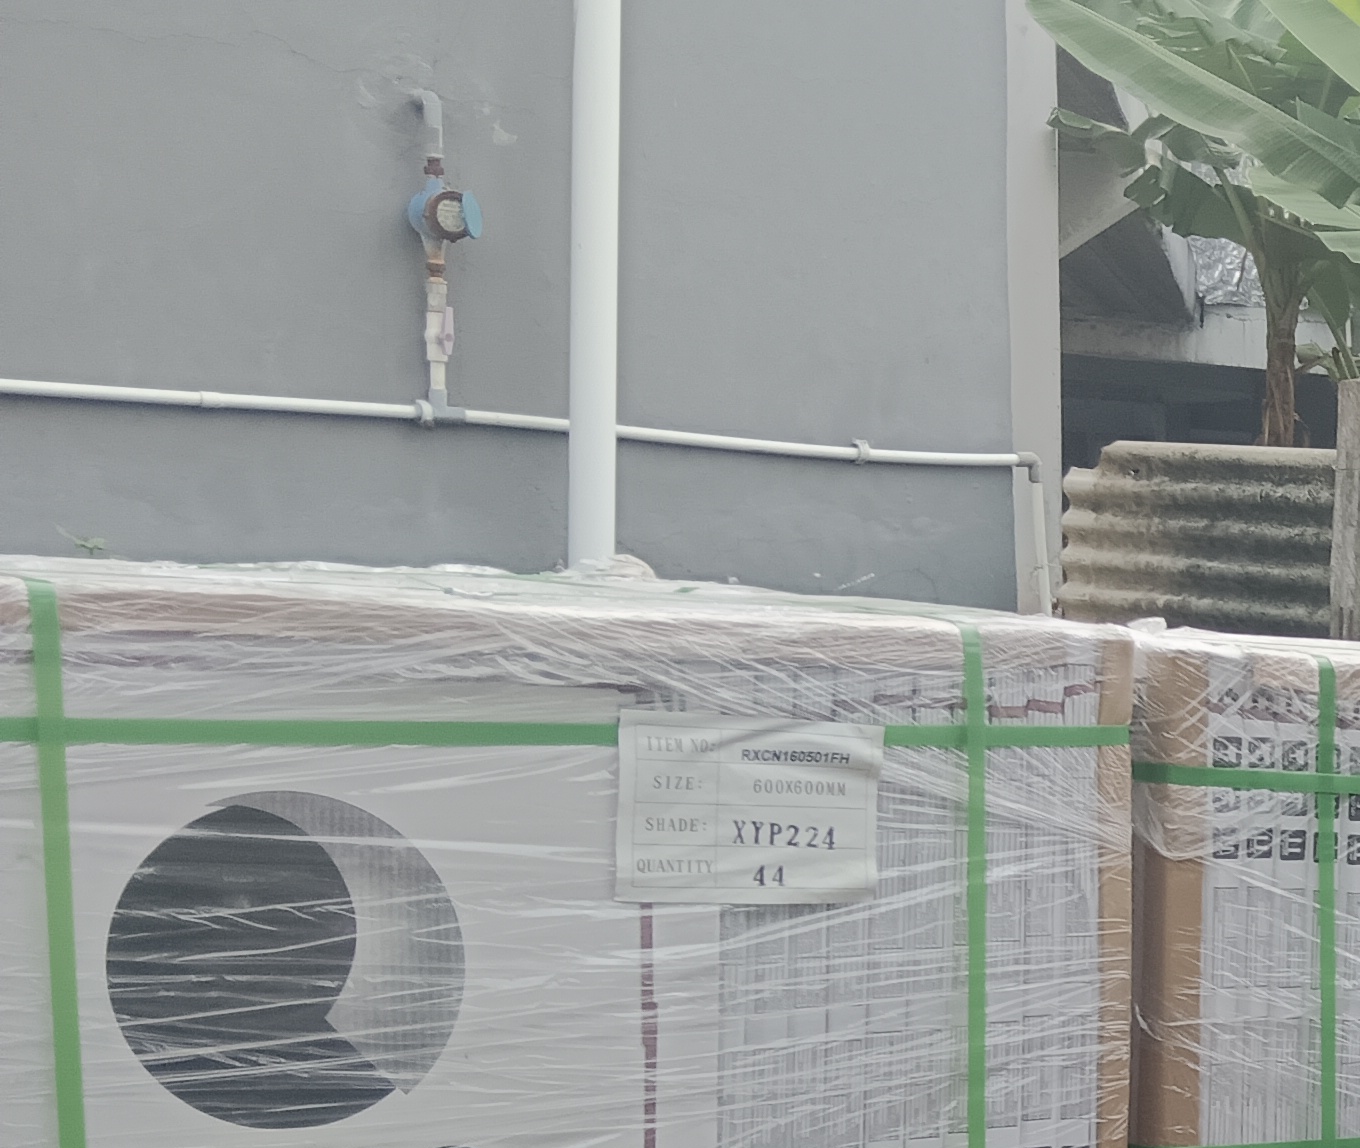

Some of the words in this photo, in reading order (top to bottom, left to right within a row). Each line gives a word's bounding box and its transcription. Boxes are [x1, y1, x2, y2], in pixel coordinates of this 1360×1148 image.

[646, 735, 684, 753] ITEM
[653, 775, 703, 791] SIZE:
[752, 778, 847, 797] 600X600MM
[645, 817, 708, 833] SHADE:
[731, 819, 836, 850] XYP224
[636, 858, 714, 874] QUANTITY
[752, 865, 786, 887] 44
